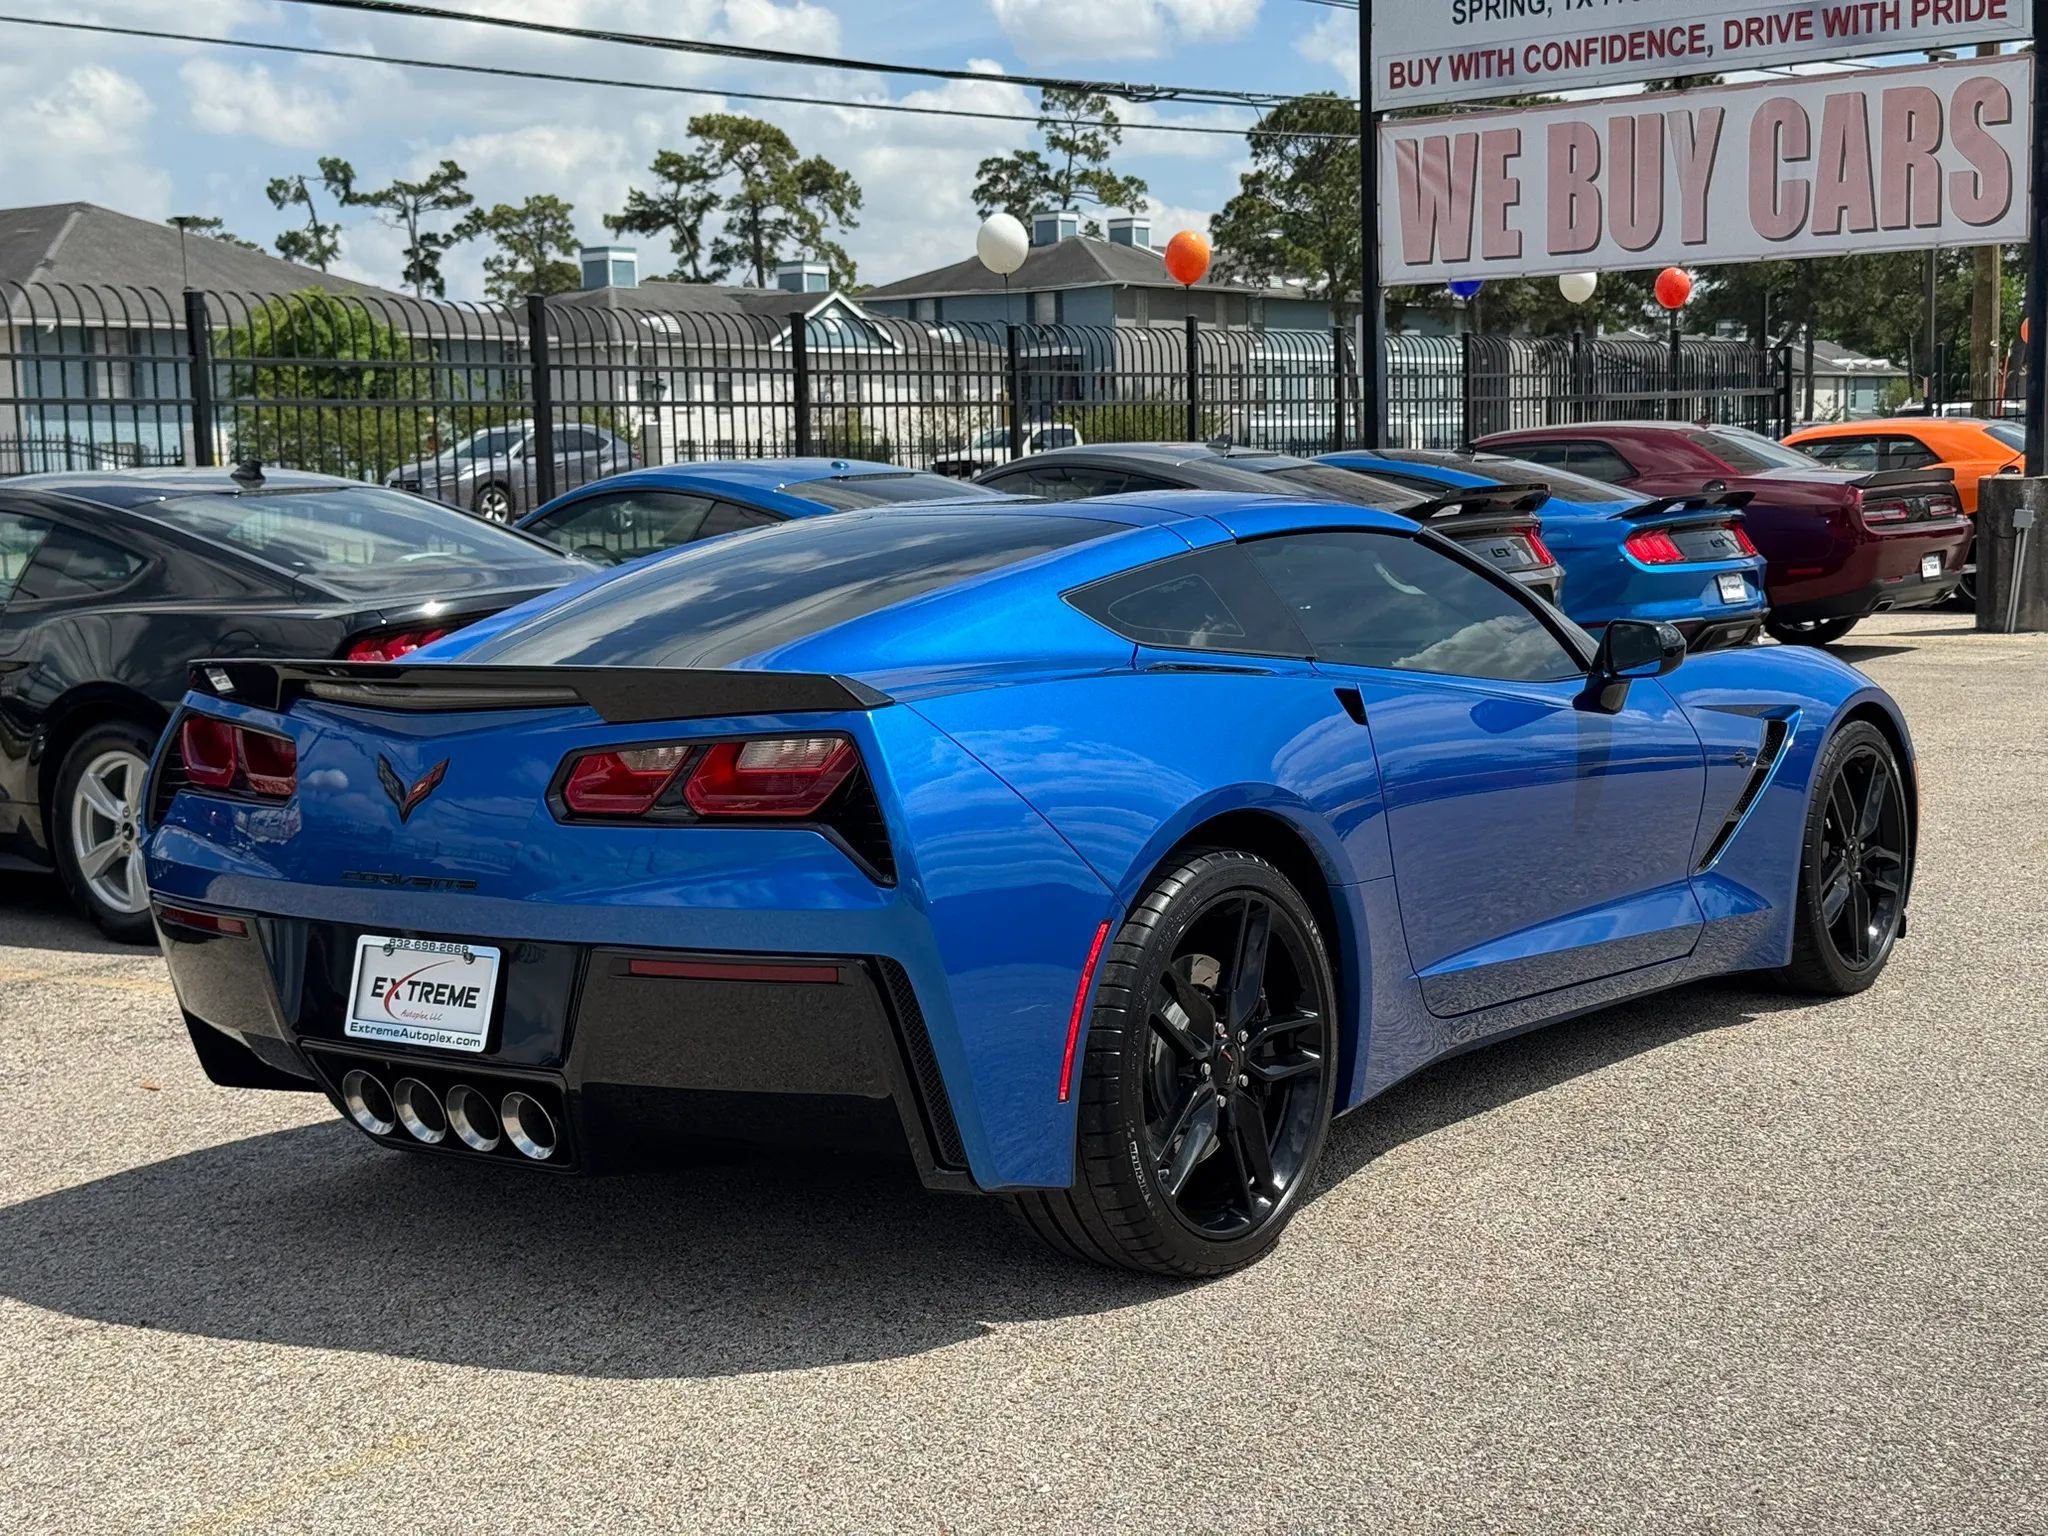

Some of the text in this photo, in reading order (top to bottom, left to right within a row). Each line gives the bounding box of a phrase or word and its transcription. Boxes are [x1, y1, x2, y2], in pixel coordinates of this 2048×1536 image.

[1452, 0, 1552, 25] SPRING,
[1390, 0, 2008, 90] BUY WITH CONFIDENCE, DRIVE WITH PRIDE
[1395, 76, 2012, 265] WE BUY CARS
[371, 976, 480, 1009] EXTREME
[350, 1021, 481, 1047] ExtremeAutoplex.com
